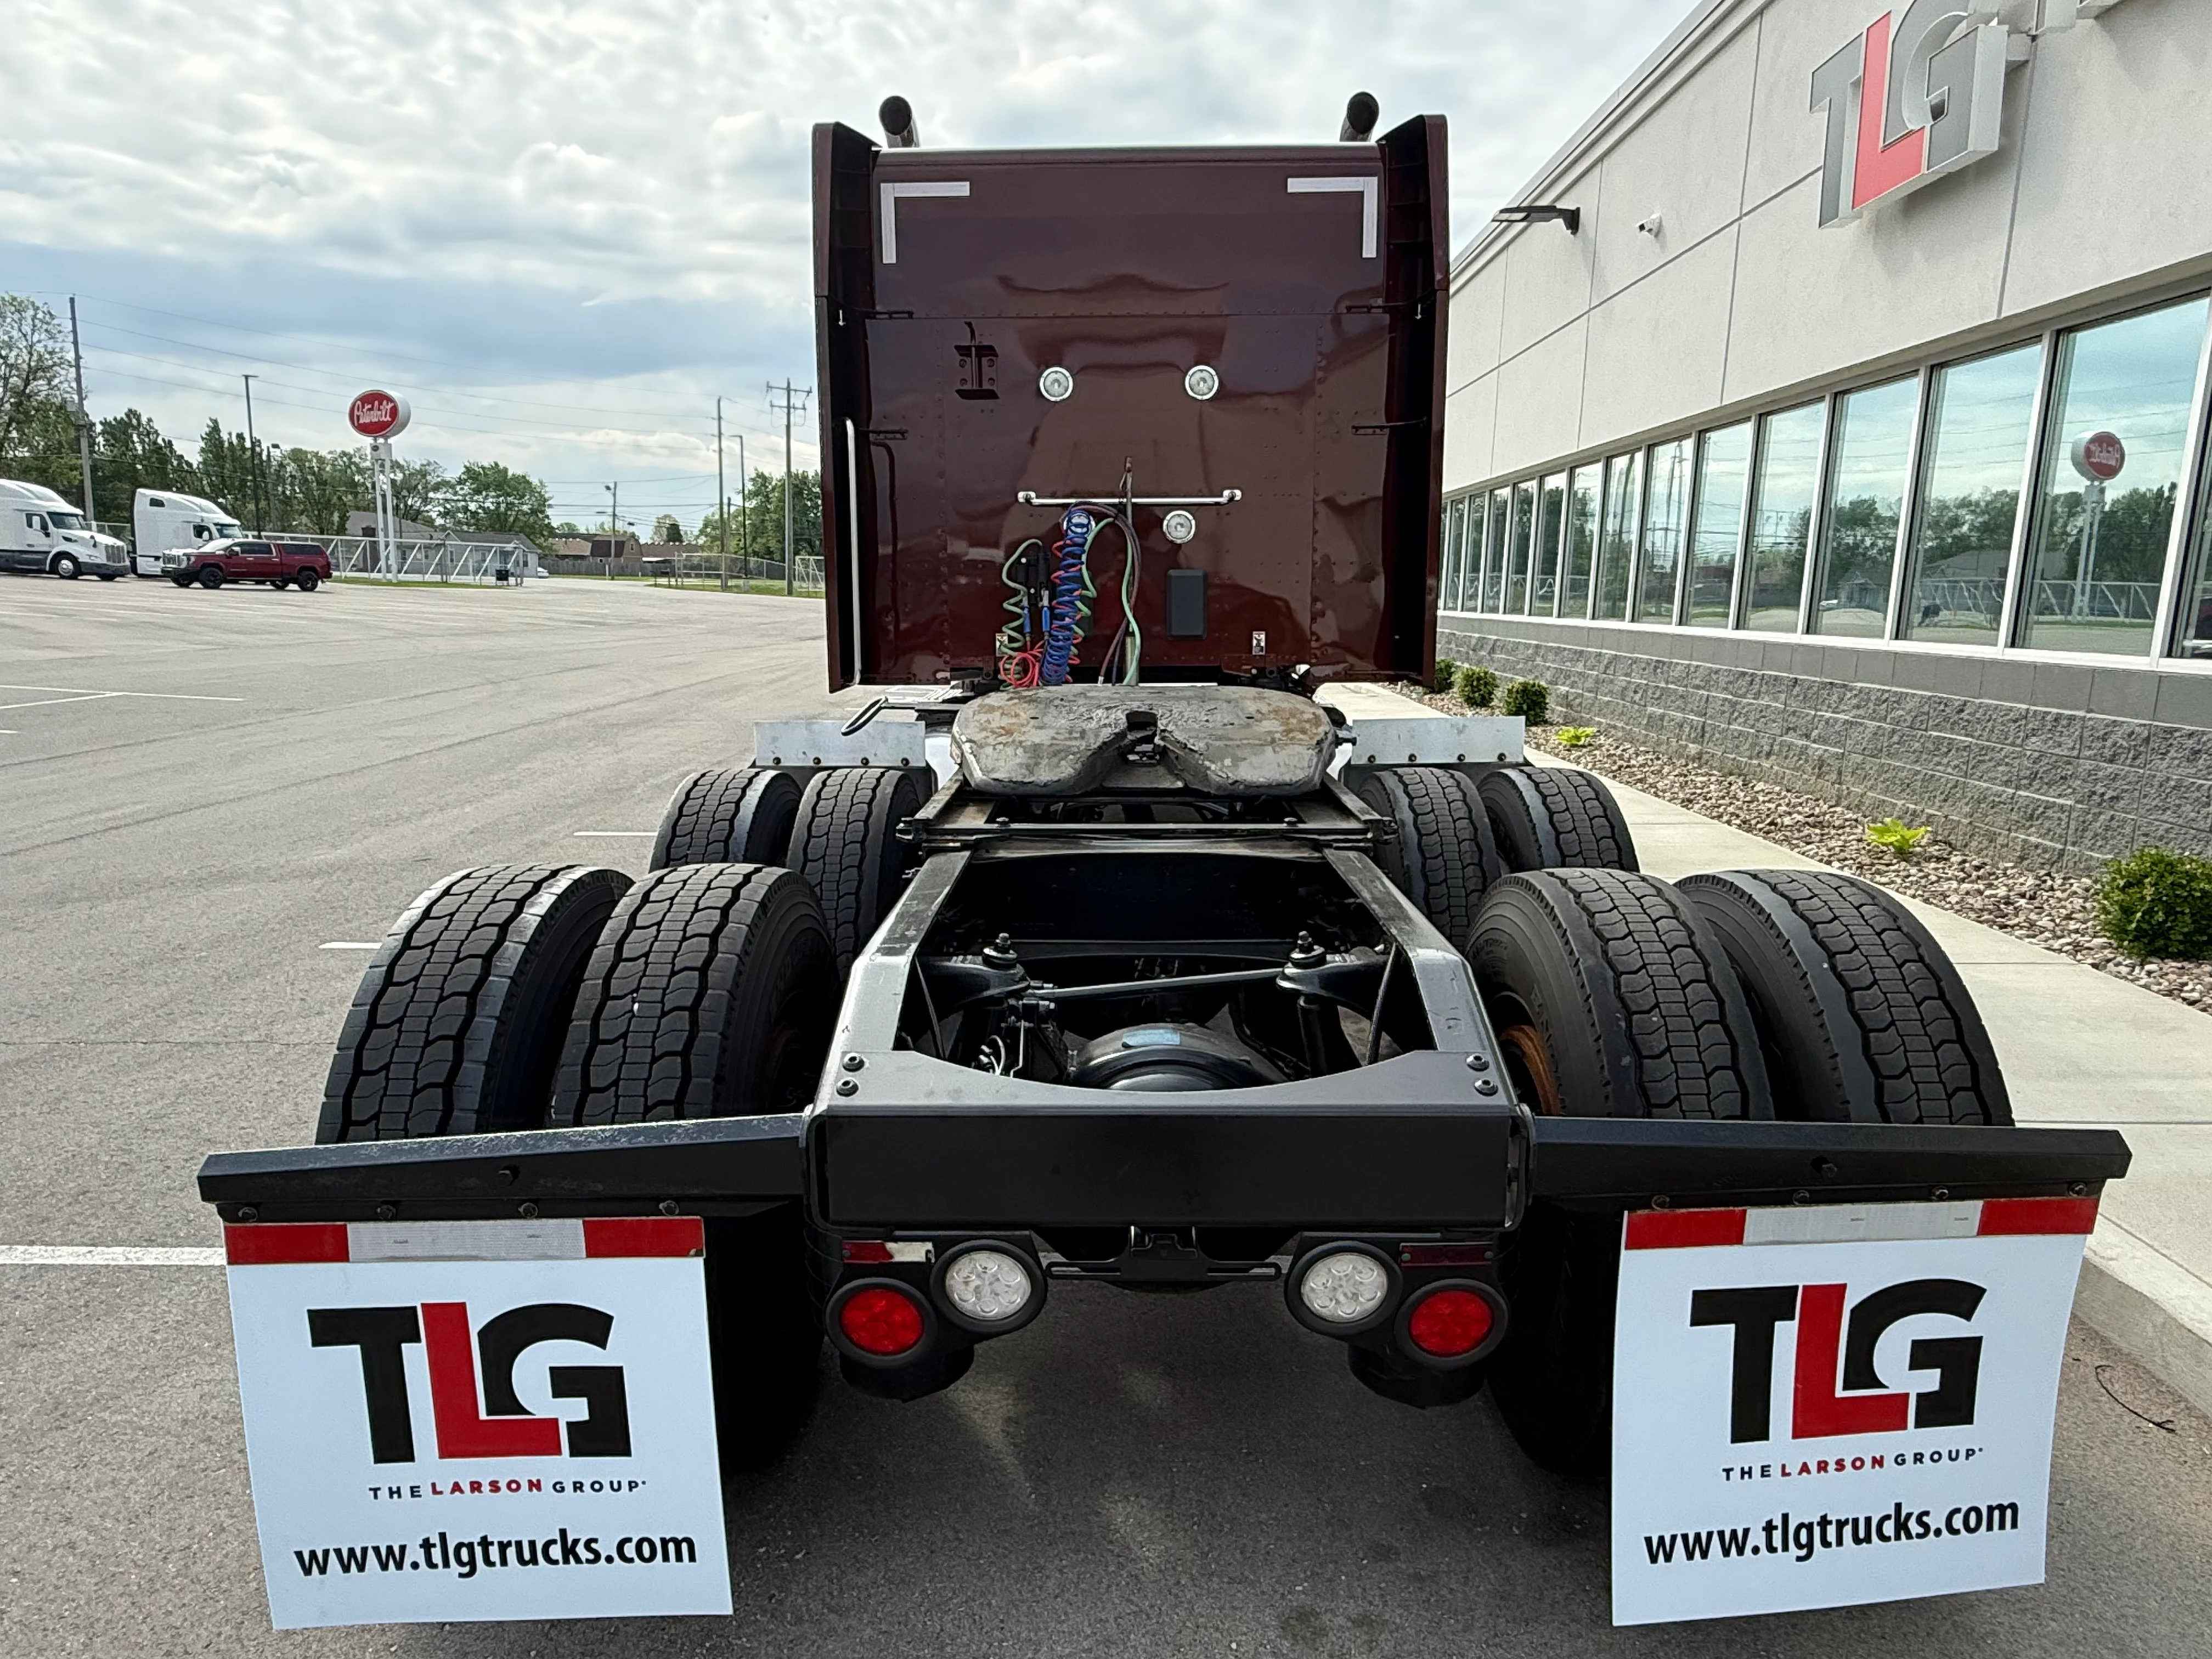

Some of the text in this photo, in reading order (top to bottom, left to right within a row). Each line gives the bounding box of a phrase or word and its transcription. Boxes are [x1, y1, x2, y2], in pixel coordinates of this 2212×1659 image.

[1810, 0, 1986, 229] TLG
[307, 1301, 632, 1464] TLG
[1690, 1278, 1987, 1444] TLG
[369, 1479, 640, 1500] THE LARSON GROUP
[1722, 1448, 1977, 1481] THE LARSON GROUP
[294, 1527, 697, 1579] www.tlgtrucks.com
[1644, 1501, 2019, 1564] www.tlgtrucks.com
